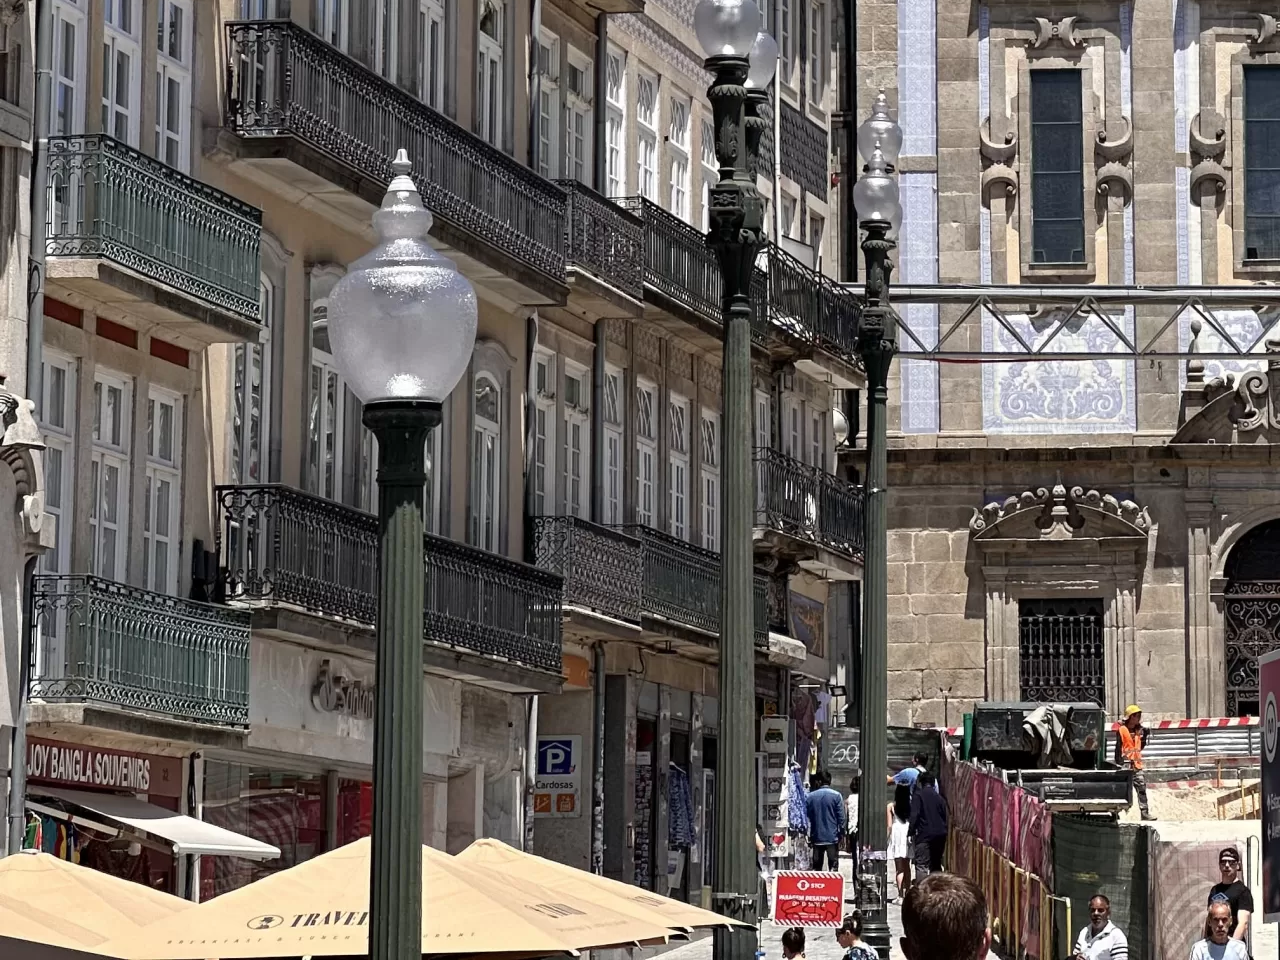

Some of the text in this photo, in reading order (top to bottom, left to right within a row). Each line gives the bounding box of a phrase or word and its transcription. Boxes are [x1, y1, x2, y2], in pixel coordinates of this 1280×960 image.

[27, 744, 150, 790] JOY BANGLA SOUVENIRS
[536, 780, 573, 789] Cardosas
